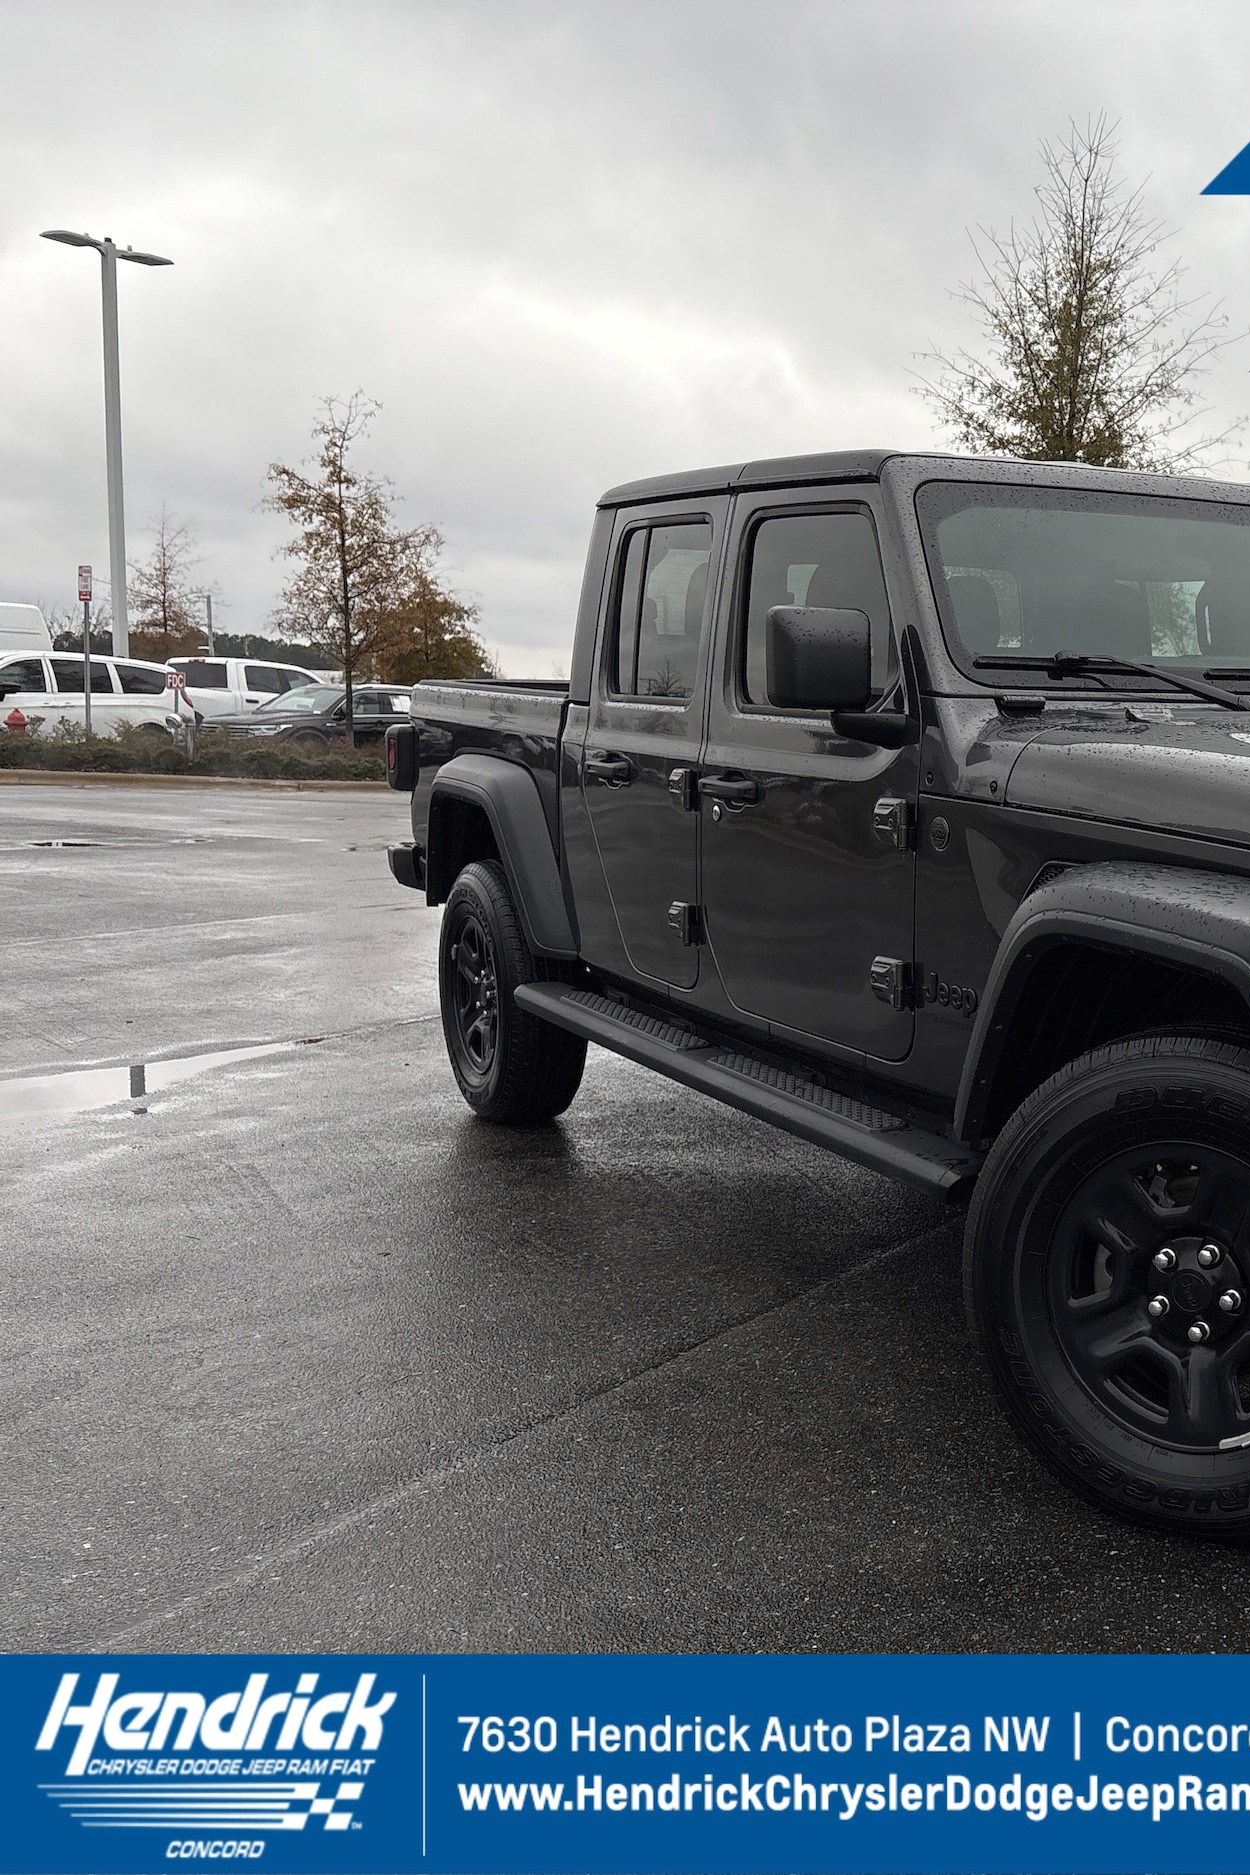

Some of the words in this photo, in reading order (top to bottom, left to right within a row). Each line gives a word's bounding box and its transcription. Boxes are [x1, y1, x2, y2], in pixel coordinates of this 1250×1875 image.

[167, 674, 184, 688] FDC
[923, 971, 978, 1018] Jeep
[1181, 1277, 1198, 1307] Jeep
